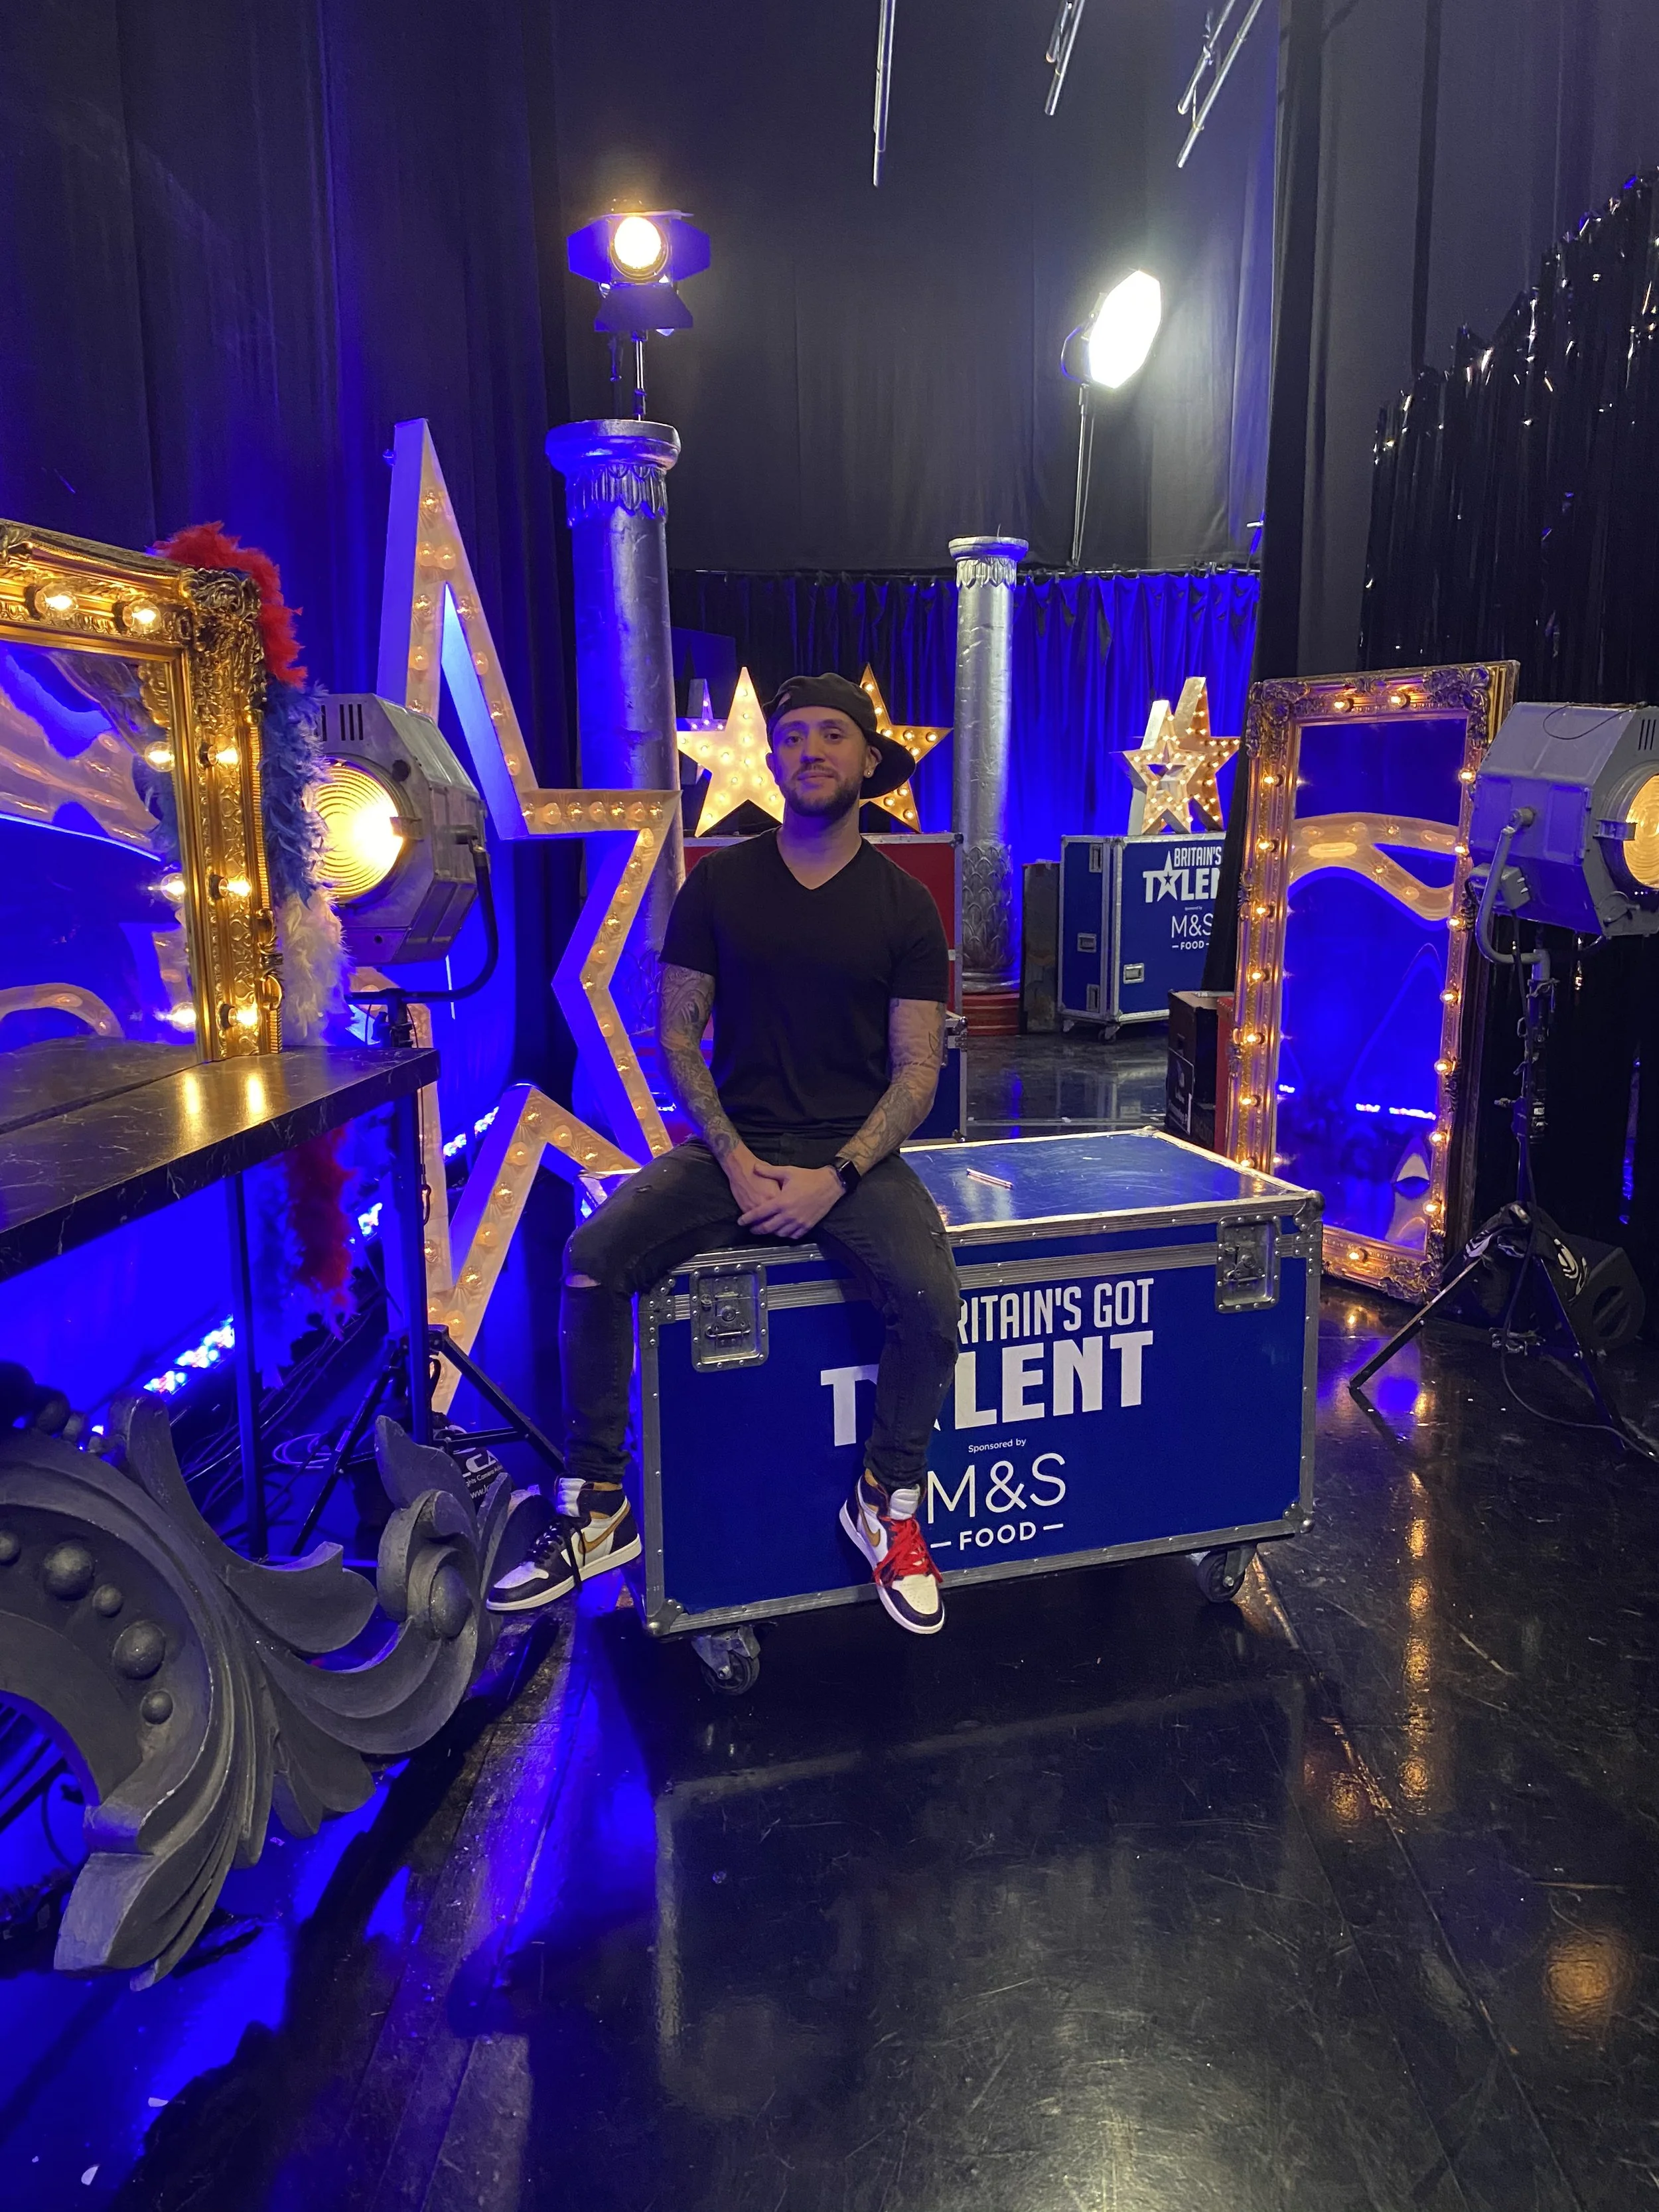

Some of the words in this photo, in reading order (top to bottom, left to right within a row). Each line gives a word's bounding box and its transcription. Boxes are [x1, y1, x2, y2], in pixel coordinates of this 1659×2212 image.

[1174, 846, 1222, 867] BRITAIN'S
[1171, 913, 1214, 938] M&S
[1181, 940, 1204, 950] FOOD
[957, 1286, 1082, 1344] RITAIN'S
[1094, 1278, 1154, 1328] GOT
[820, 1330, 1154, 1447] TLENT
[968, 1439, 1013, 1453] Sponsored
[927, 1453, 1066, 1524] M&S
[960, 1522, 1037, 1550] FOOD
